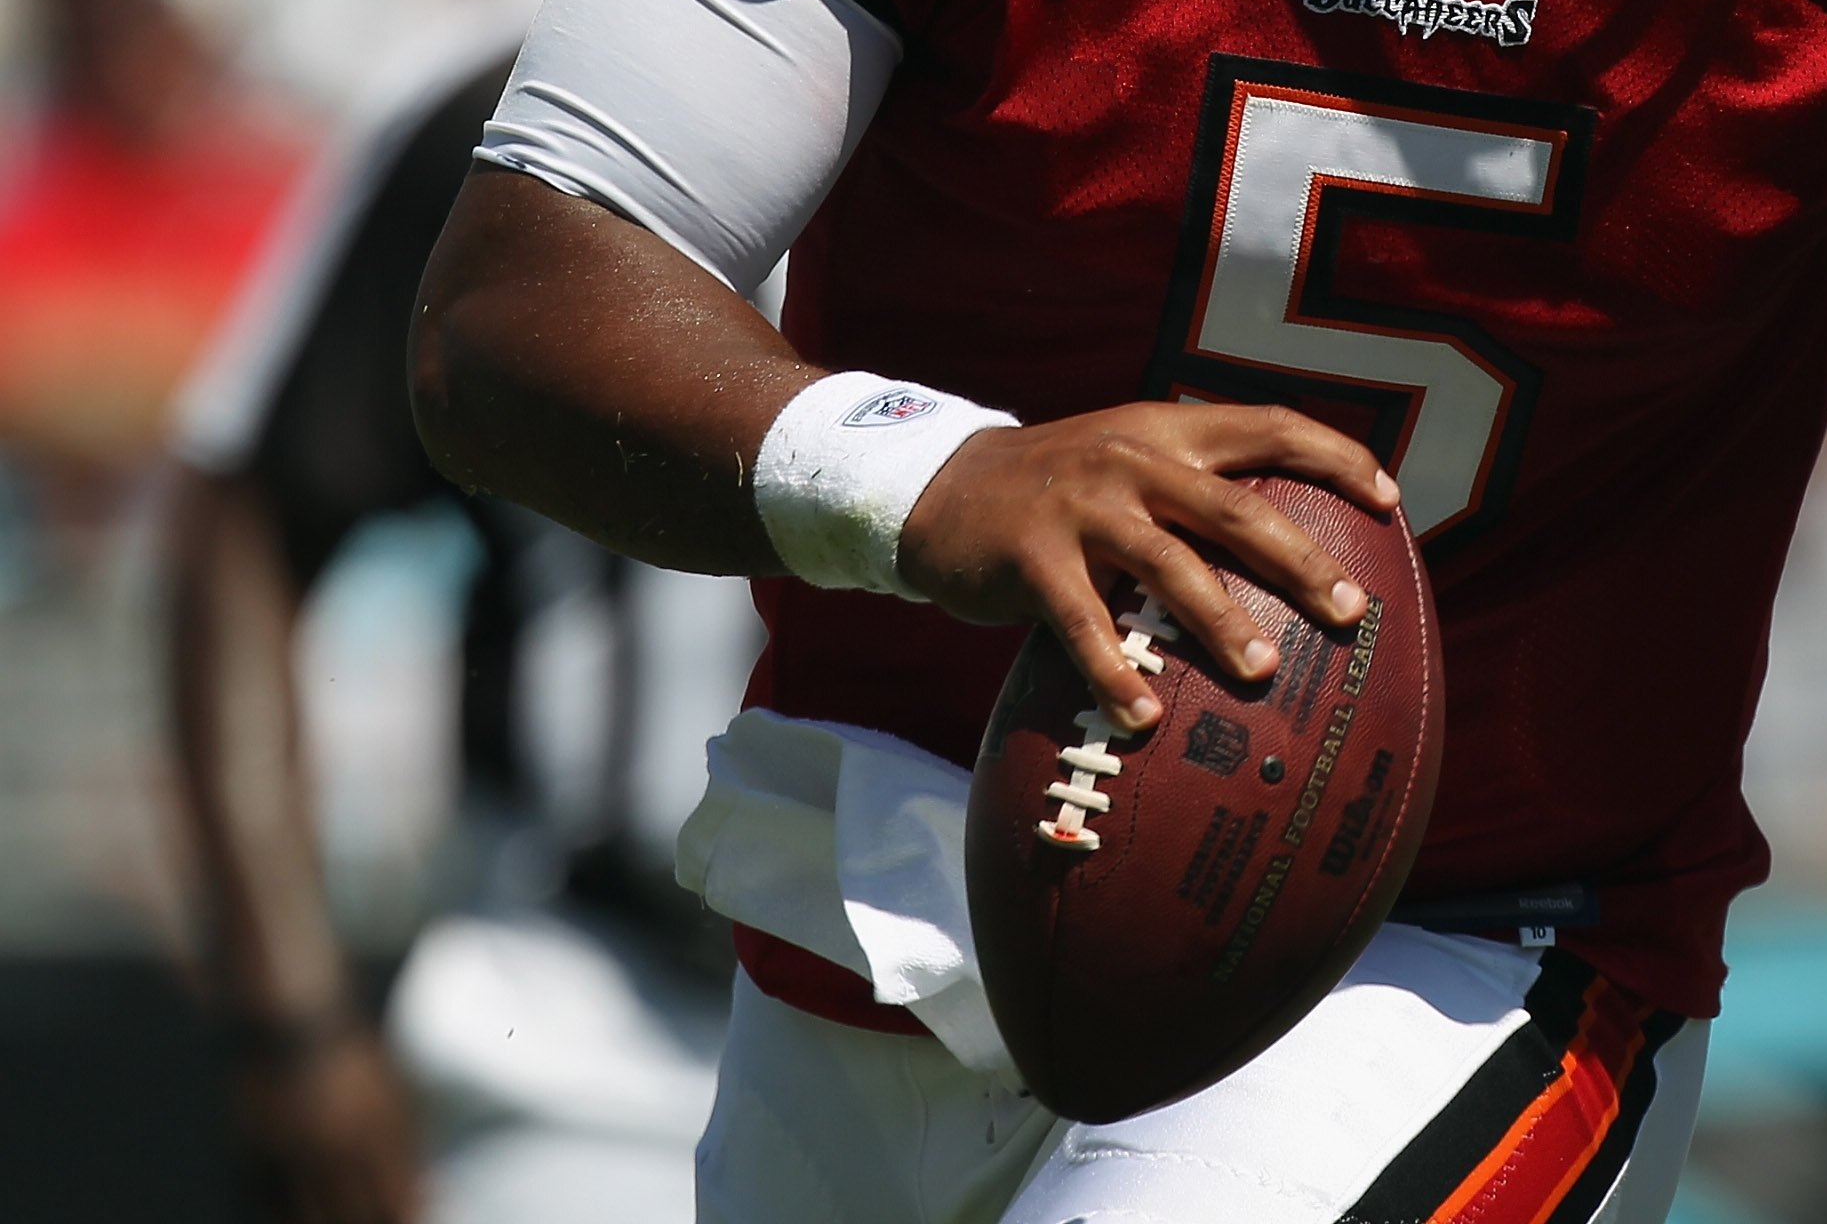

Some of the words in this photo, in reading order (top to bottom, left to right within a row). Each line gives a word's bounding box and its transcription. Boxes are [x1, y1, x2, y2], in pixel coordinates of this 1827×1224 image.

[1150, 56, 1598, 561] 5
[1214, 855, 1292, 983] NATIONAL
[1285, 704, 1354, 848] FOOTBALL
[1343, 594, 1383, 697] LEAGUE
[1518, 896, 1575, 910] Reebok
[1531, 926, 1547, 939] 10
